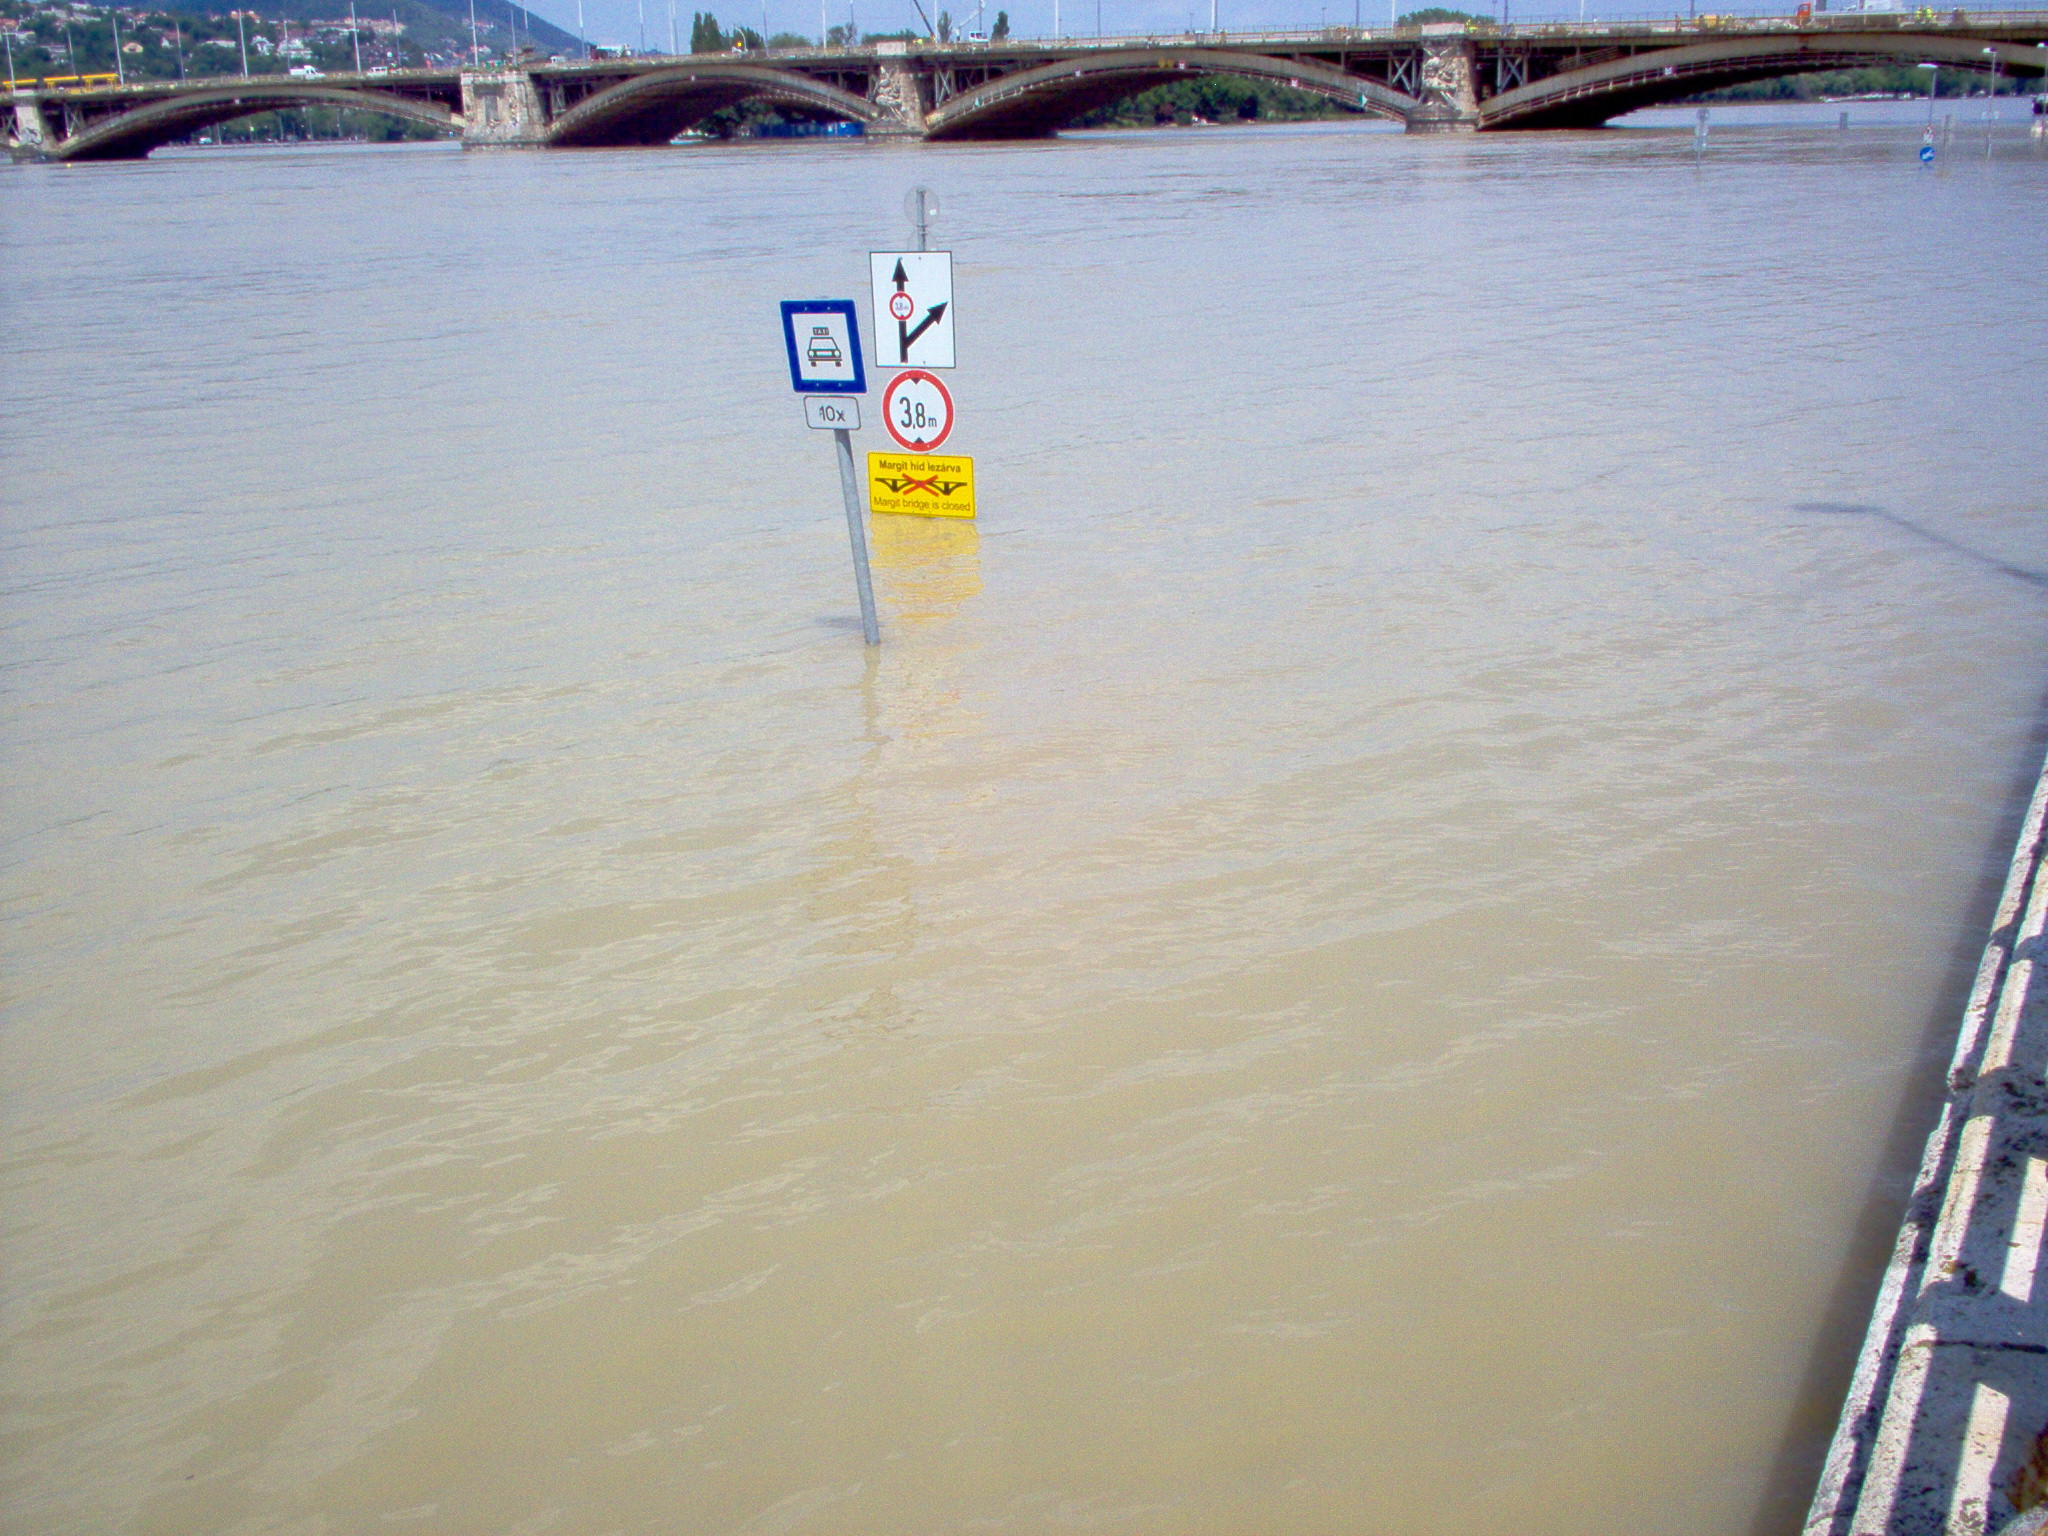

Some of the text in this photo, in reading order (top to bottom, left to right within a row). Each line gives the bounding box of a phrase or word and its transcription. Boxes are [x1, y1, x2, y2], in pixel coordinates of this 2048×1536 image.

[819, 405, 846, 422] 10x
[879, 460, 908, 472] Margit
[874, 496, 971, 511] Margit bridge is closed
